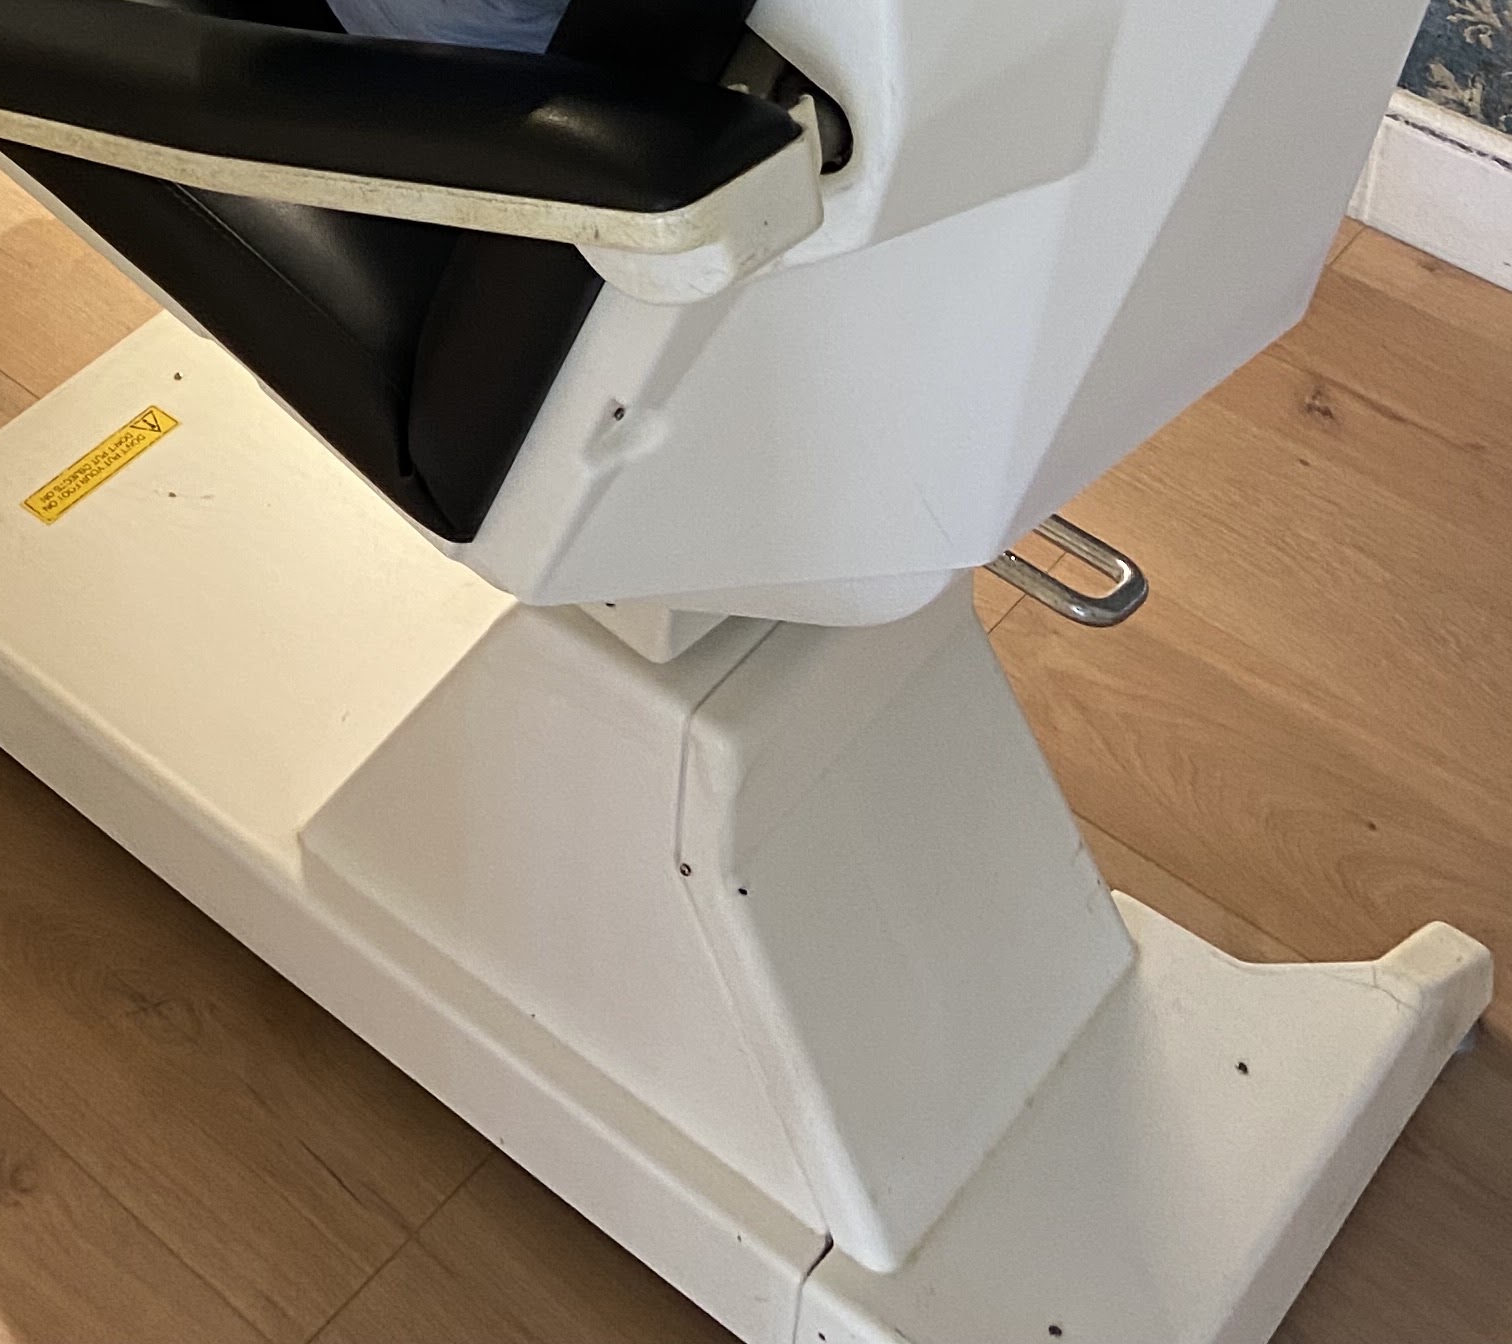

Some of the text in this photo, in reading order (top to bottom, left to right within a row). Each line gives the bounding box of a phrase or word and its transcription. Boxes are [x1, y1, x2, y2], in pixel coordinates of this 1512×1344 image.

[91, 451, 108, 465] PUT
[104, 452, 122, 466] PUT
[79, 466, 105, 485] YOUR
[40, 491, 55, 503] ON
[42, 500, 58, 512] ON
